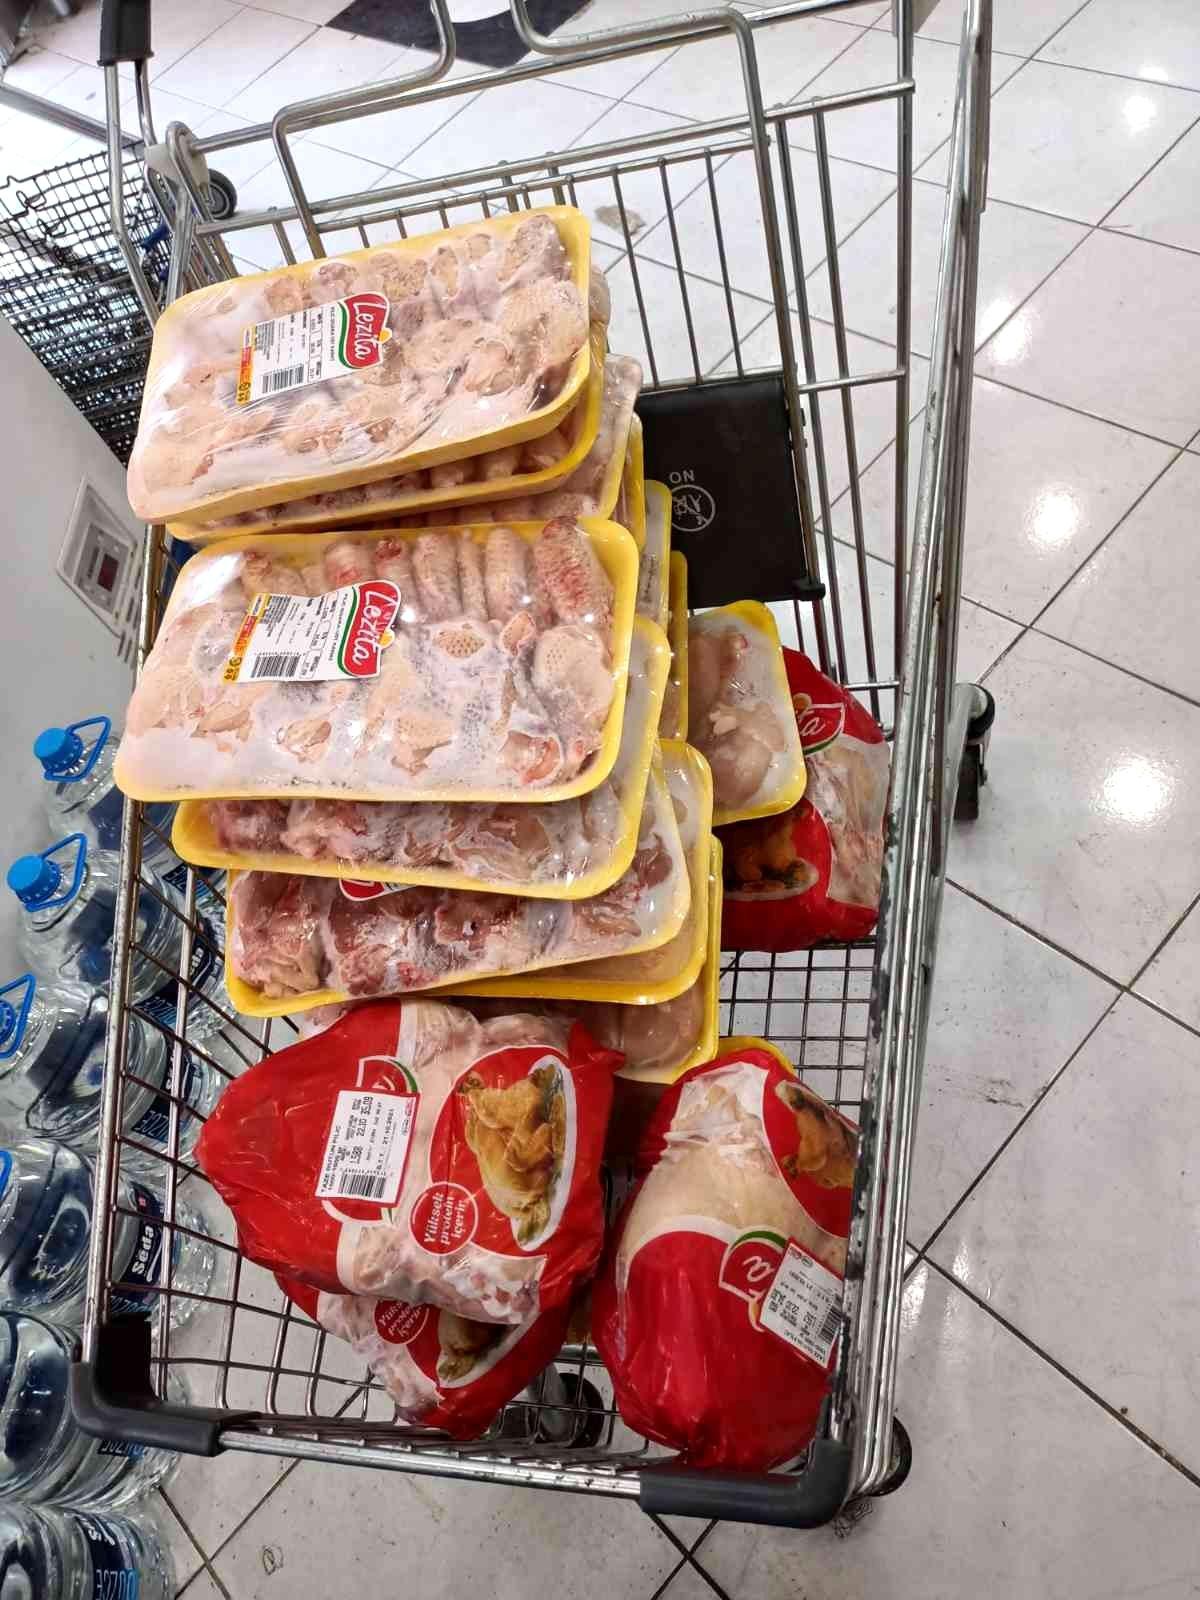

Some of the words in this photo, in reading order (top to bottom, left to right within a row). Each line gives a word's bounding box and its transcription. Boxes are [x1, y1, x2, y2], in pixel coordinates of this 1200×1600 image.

[353, 302, 388, 360] Lezita
[669, 469, 695, 484] NO
[351, 590, 398, 667] Lezita
[424, 1192, 444, 1242] Yüksek
[440, 1196, 455, 1245] protein
